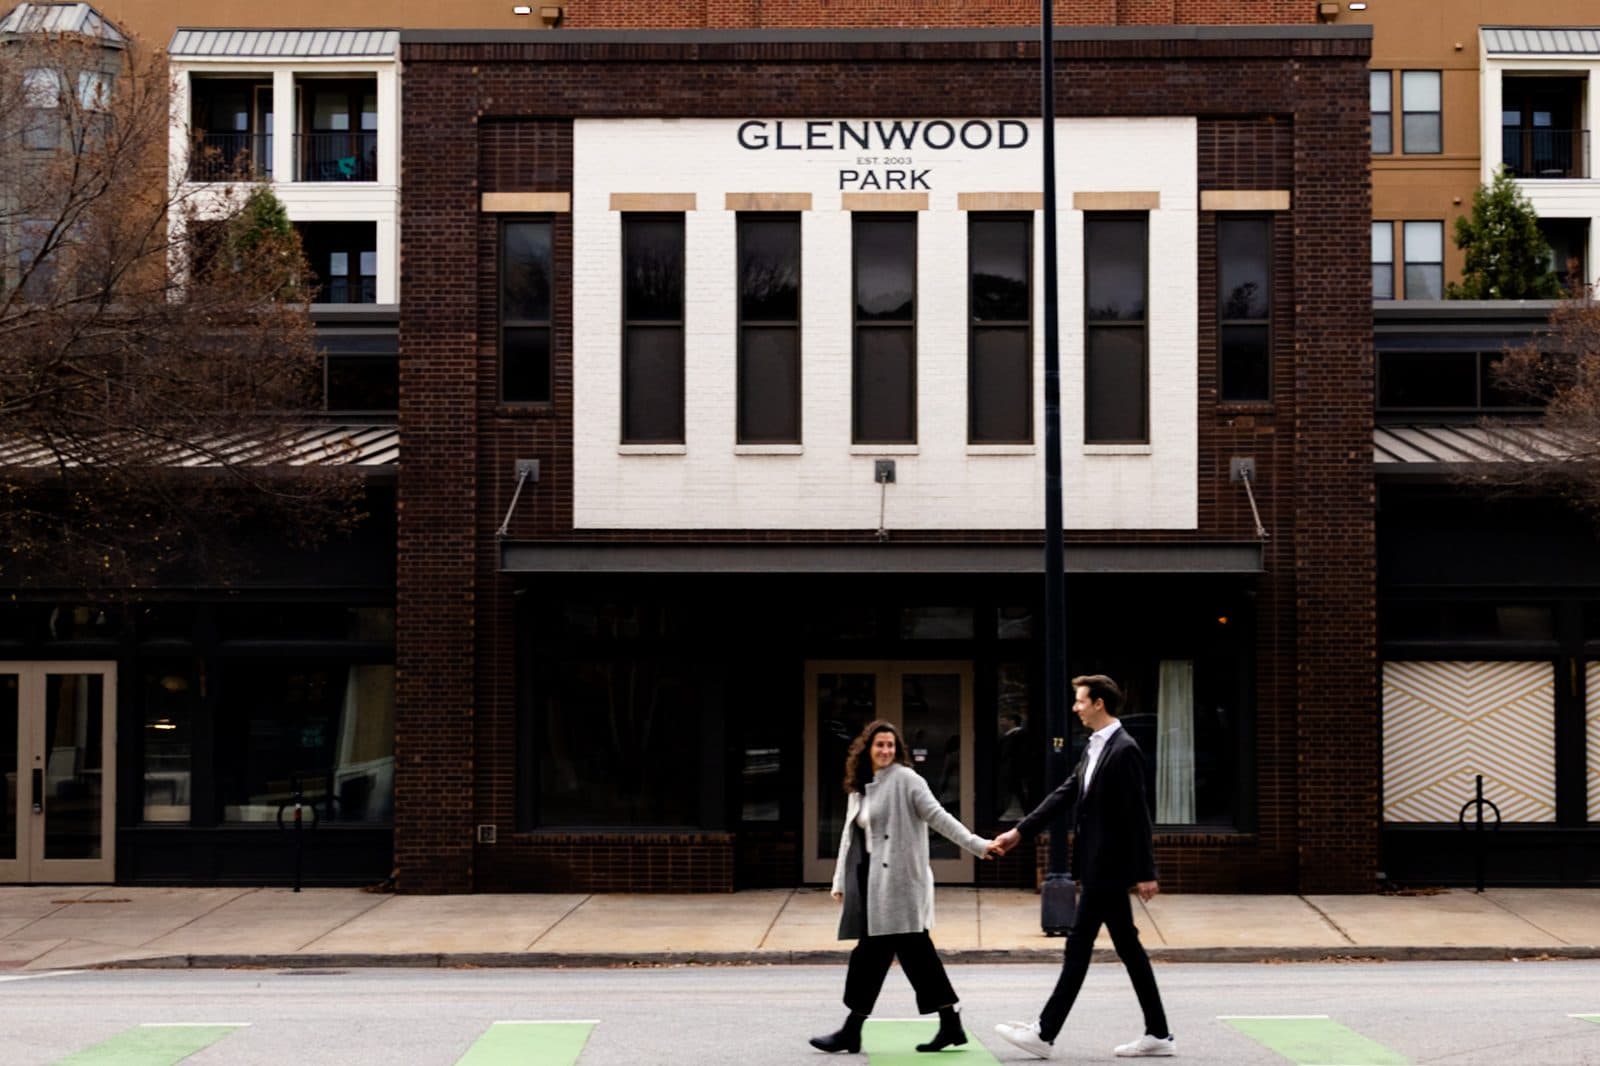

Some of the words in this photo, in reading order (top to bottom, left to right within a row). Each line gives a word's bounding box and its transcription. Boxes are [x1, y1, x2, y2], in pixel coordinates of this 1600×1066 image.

[737, 120, 1029, 150] GLENWOOD
[856, 157, 880, 165] EST.
[883, 157, 912, 165] 2003
[839, 169, 932, 190] PARK
